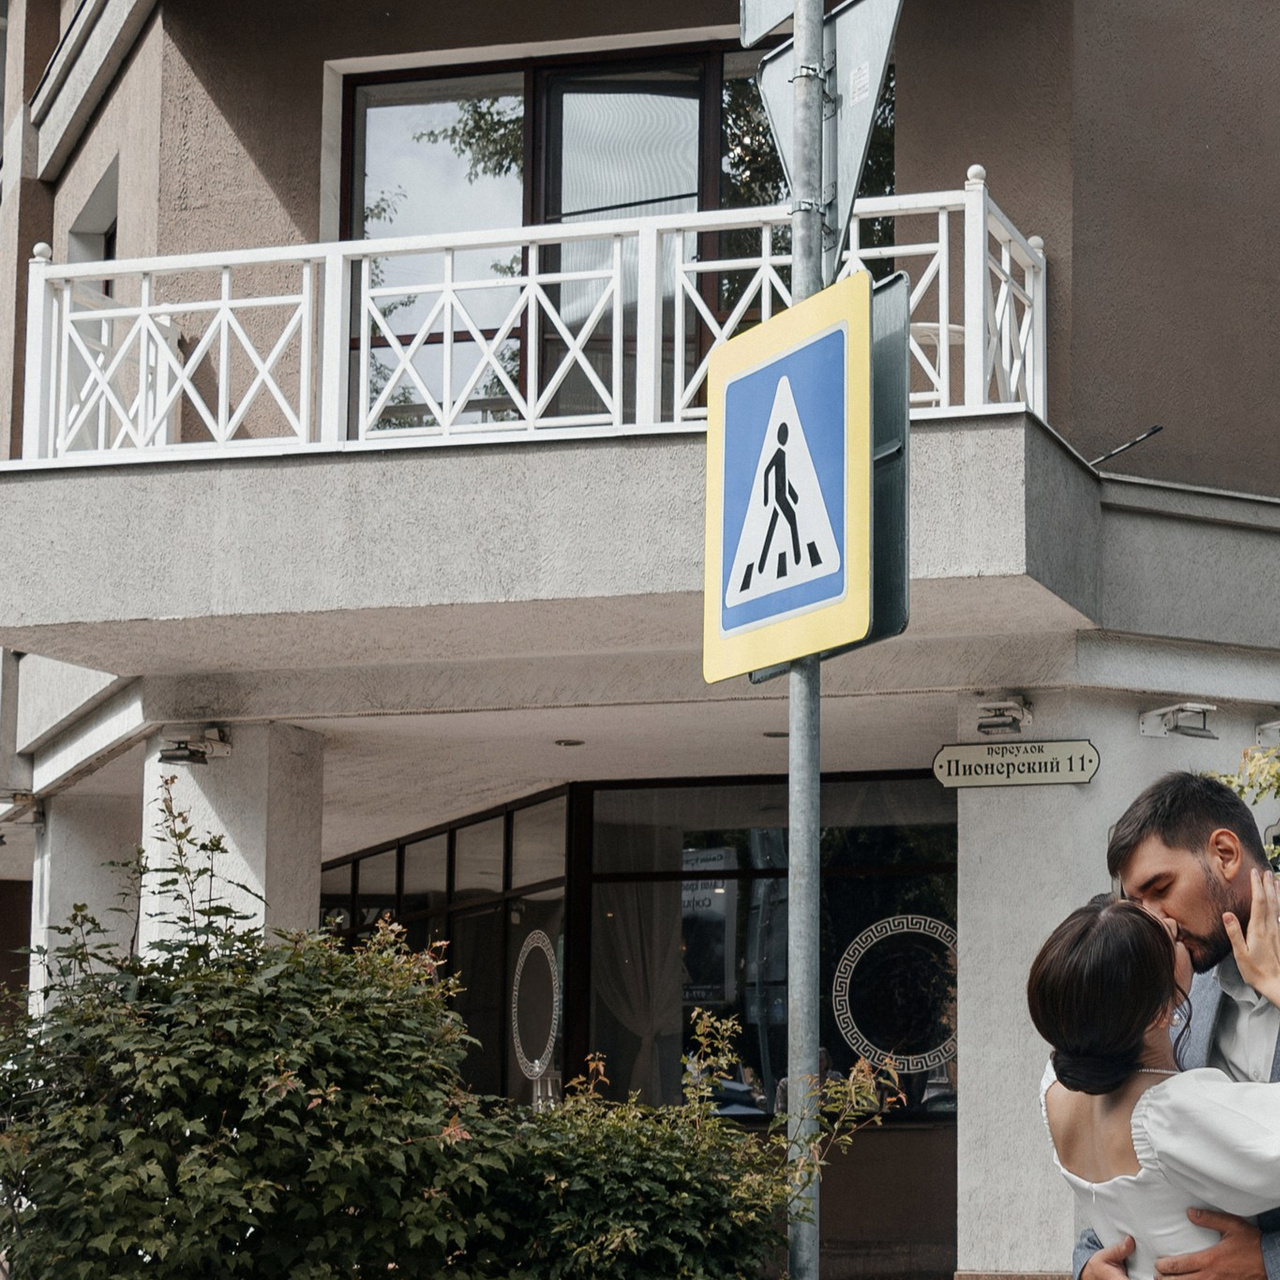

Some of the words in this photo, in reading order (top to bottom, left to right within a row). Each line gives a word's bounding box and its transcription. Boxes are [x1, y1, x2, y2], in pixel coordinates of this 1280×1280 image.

[986, 744, 1045, 757] переулок
[946, 757, 1061, 779] Пионерский
[1067, 754, 1086, 773] 11
